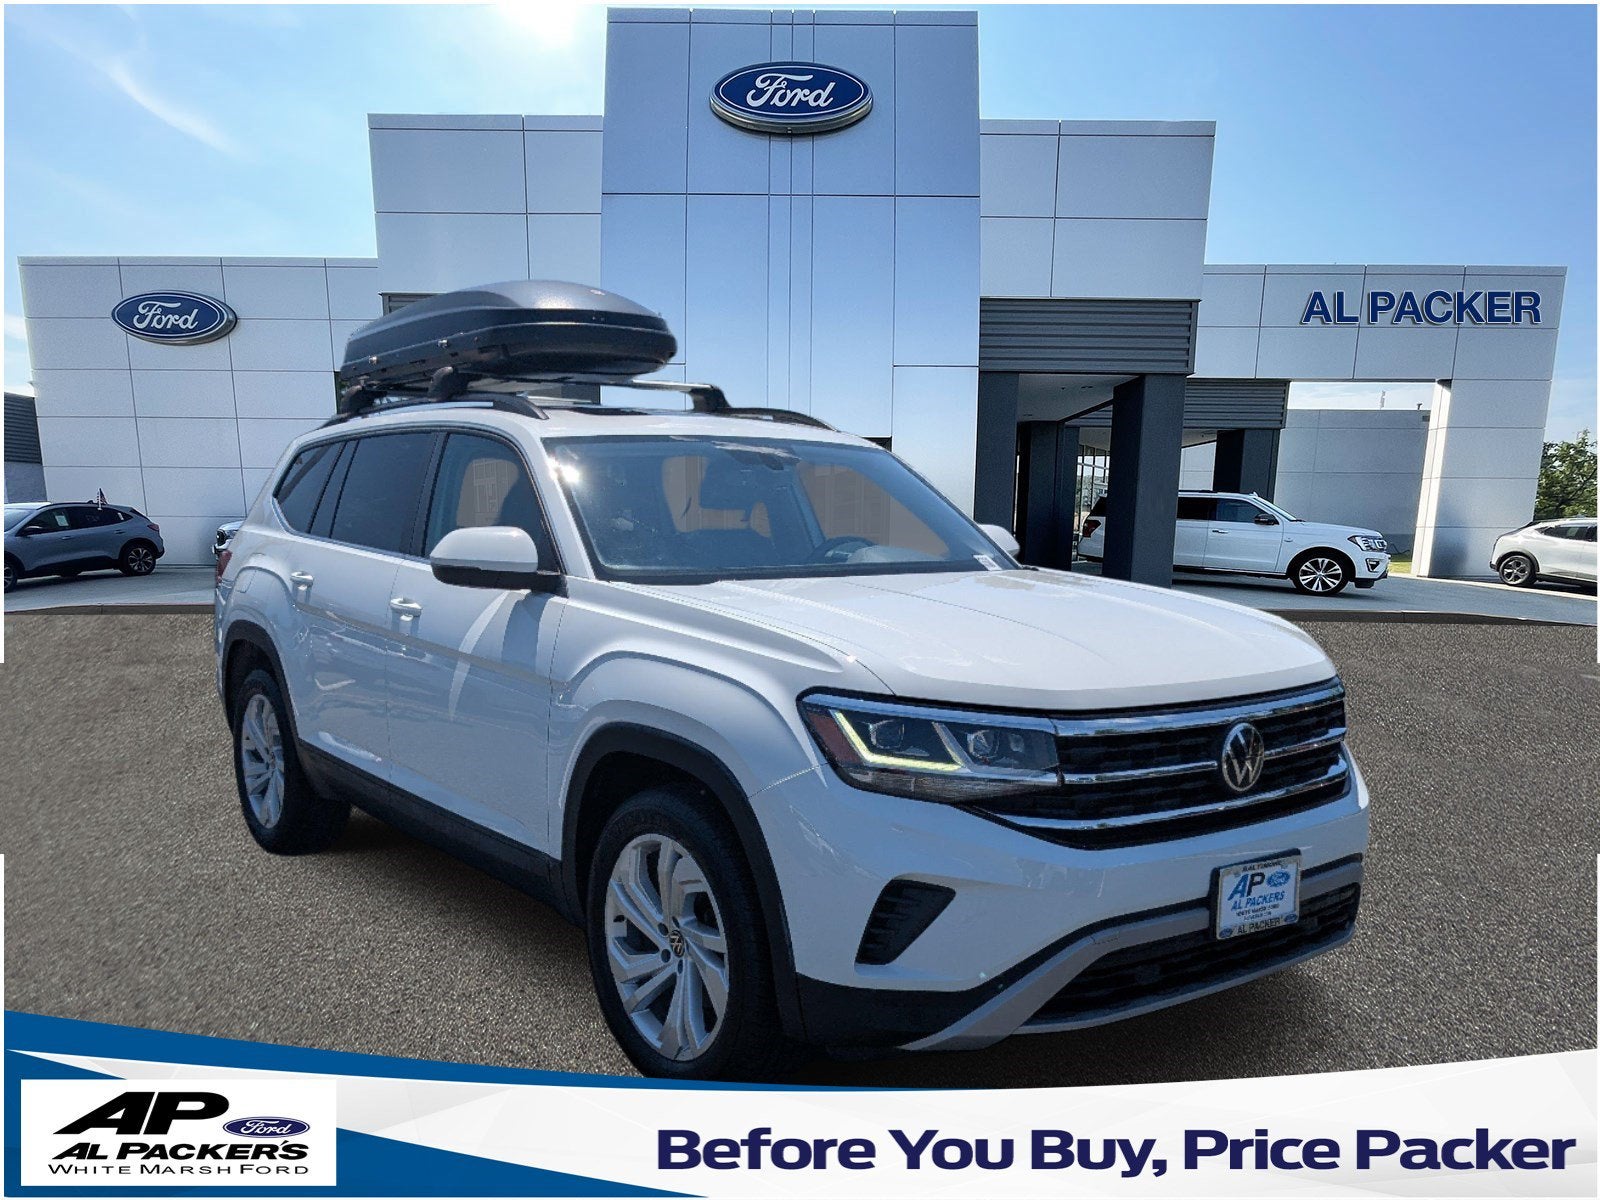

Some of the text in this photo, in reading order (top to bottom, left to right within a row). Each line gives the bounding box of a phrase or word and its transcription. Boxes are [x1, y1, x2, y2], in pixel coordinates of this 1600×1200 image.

[746, 73, 836, 107] Ford
[133, 301, 198, 329] Ford
[1302, 290, 1541, 324] AL PACKER
[1228, 872, 1266, 901] AP
[1237, 923, 1247, 934] AL
[1249, 917, 1281, 930] PACKER
